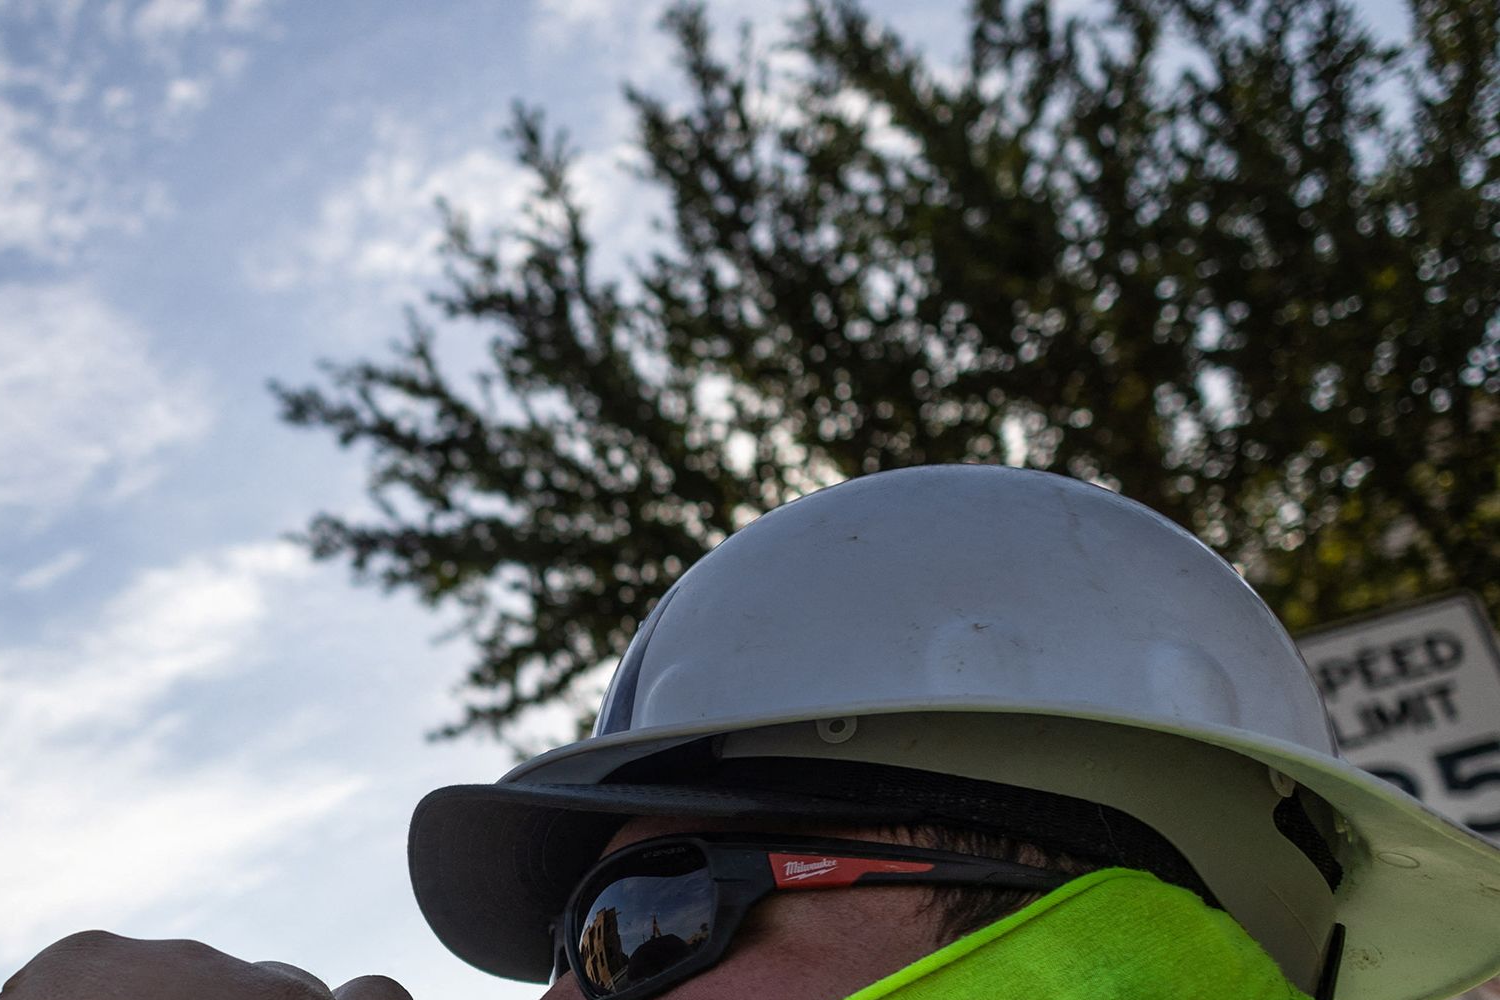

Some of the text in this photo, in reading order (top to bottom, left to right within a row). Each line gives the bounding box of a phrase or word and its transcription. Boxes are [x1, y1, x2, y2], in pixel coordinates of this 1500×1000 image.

[1318, 630, 1463, 696] PEED
[1333, 682, 1457, 748] LIMIT
[1365, 739, 1500, 834] 5
[783, 858, 837, 876] Milwaukee
